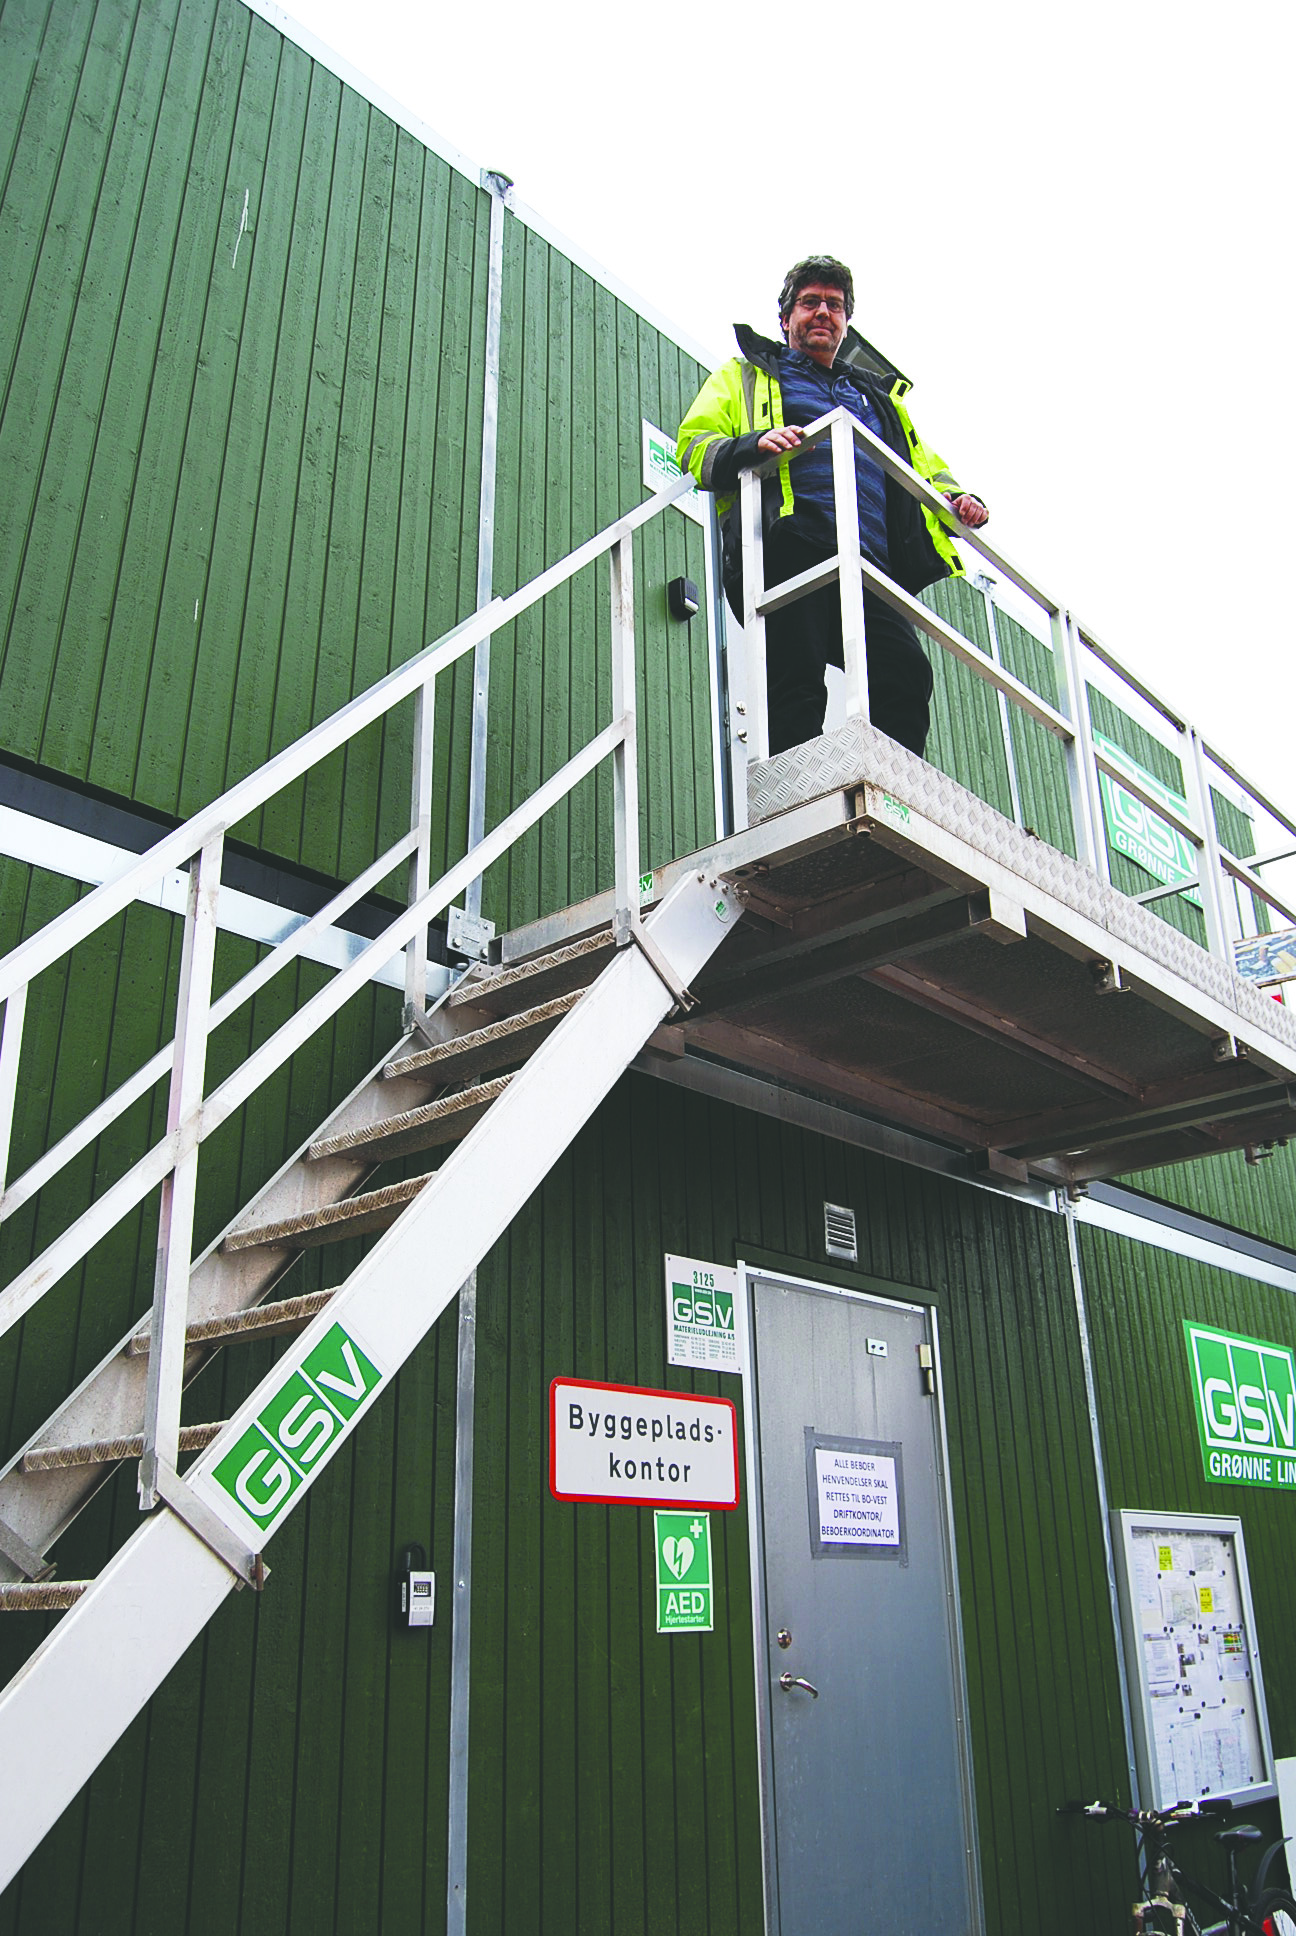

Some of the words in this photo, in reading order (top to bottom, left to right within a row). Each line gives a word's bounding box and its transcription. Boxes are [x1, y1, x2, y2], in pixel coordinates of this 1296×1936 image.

[1115, 830, 1176, 885] GRØNNE
[693, 1270, 714, 1287] 3125
[673, 1296, 733, 1329] GSV
[673, 1325, 727, 1339] MATERIELUDLEJNING
[1204, 1376, 1295, 1448] GSV
[235, 1339, 367, 1518] GSV
[609, 1452, 692, 1483] kontor
[834, 1459, 848, 1469] ALLE
[850, 1460, 875, 1471] BEBOER
[1209, 1451, 1272, 1482] GRØNNE
[822, 1475, 872, 1486] HENVENDELSER
[874, 1479, 888, 1489] SKAL
[826, 1492, 849, 1502] RETTES
[851, 1494, 860, 1503] TIL
[861, 1495, 887, 1505] BO-VEST
[833, 1509, 882, 1521] DRIFTKONTOR/
[821, 1526, 894, 1538] BEBOERKOORDINATOR
[665, 1591, 705, 1615] AED
[665, 1615, 704, 1626] Hjertestarter
